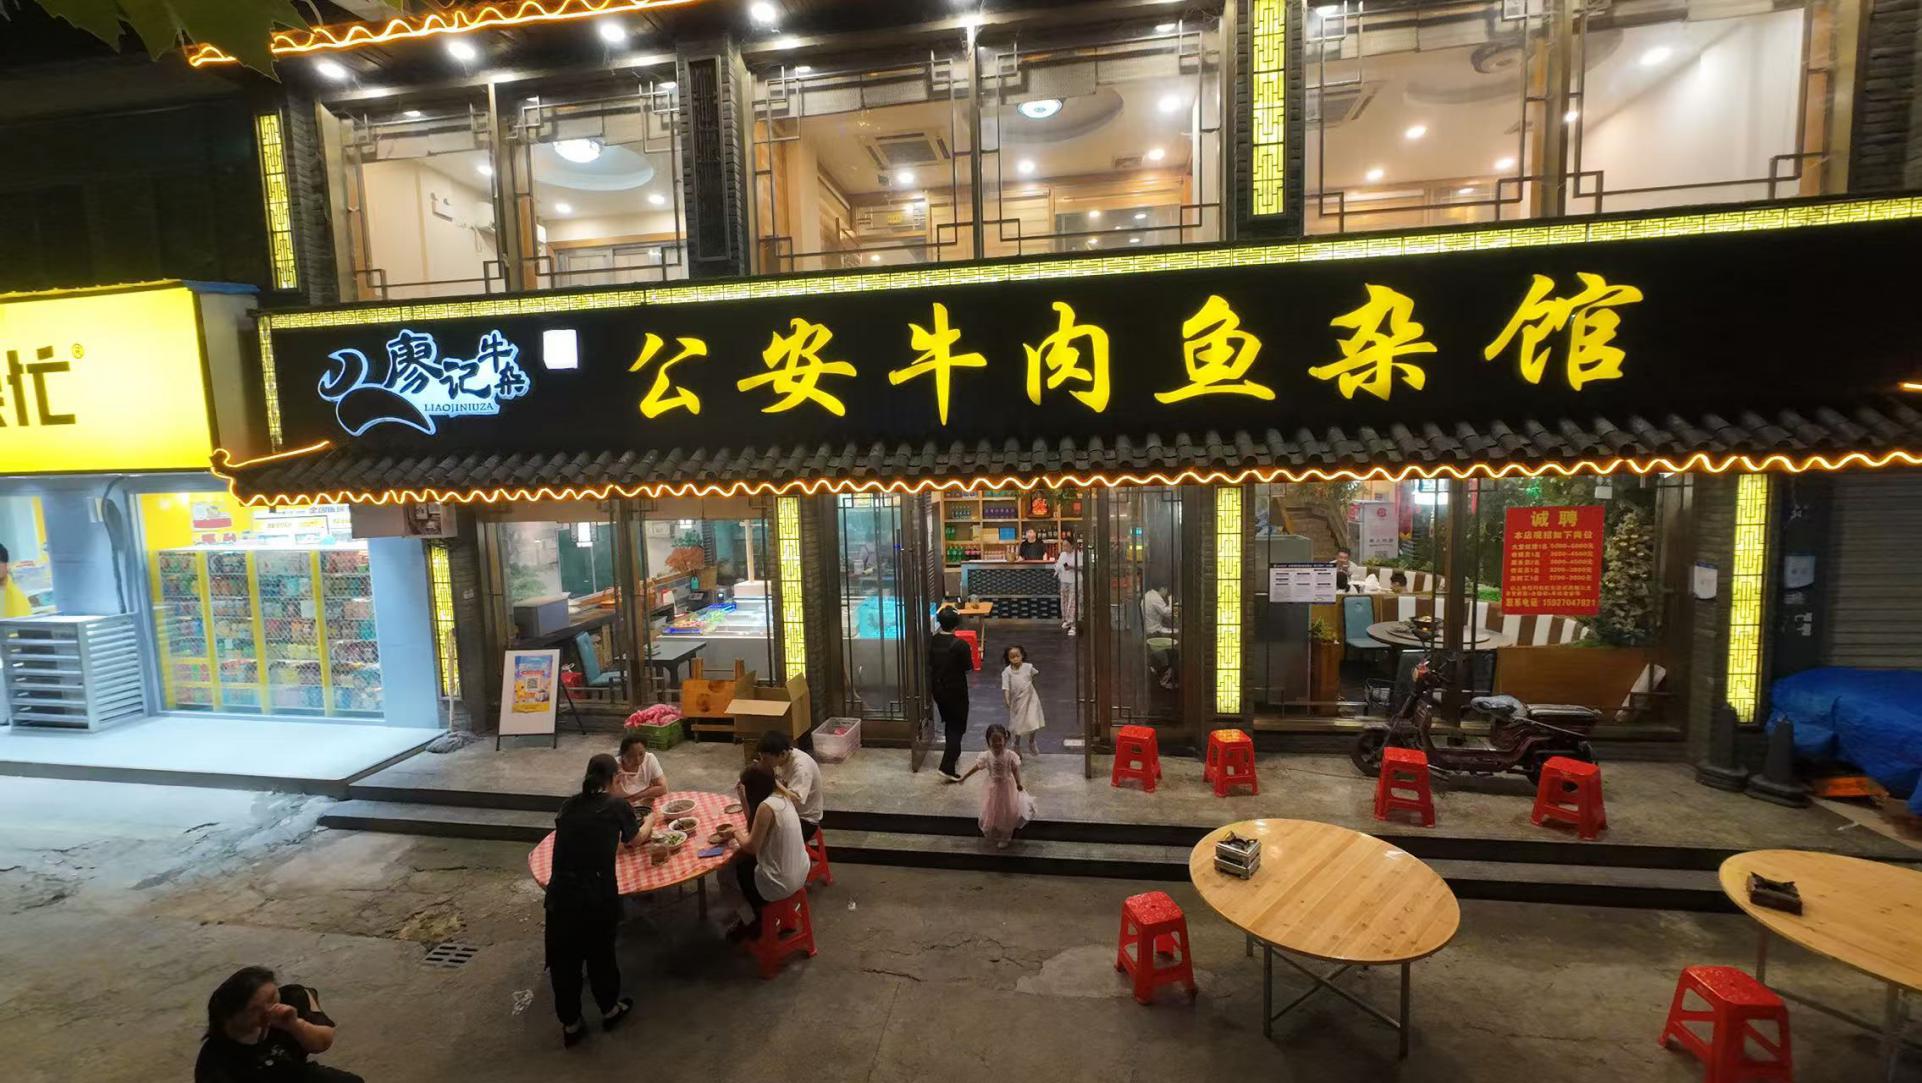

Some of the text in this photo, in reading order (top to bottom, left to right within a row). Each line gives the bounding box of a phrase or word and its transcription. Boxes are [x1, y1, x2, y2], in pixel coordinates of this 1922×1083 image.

[384, 331, 492, 400] 廖记
[628, 272, 1643, 425] 公安牛肉鱼杂馆
[0, 345, 77, 428] 忙
[424, 402, 495, 413] LIAOJINIUZA
[1530, 509, 1579, 528] 诚聘
